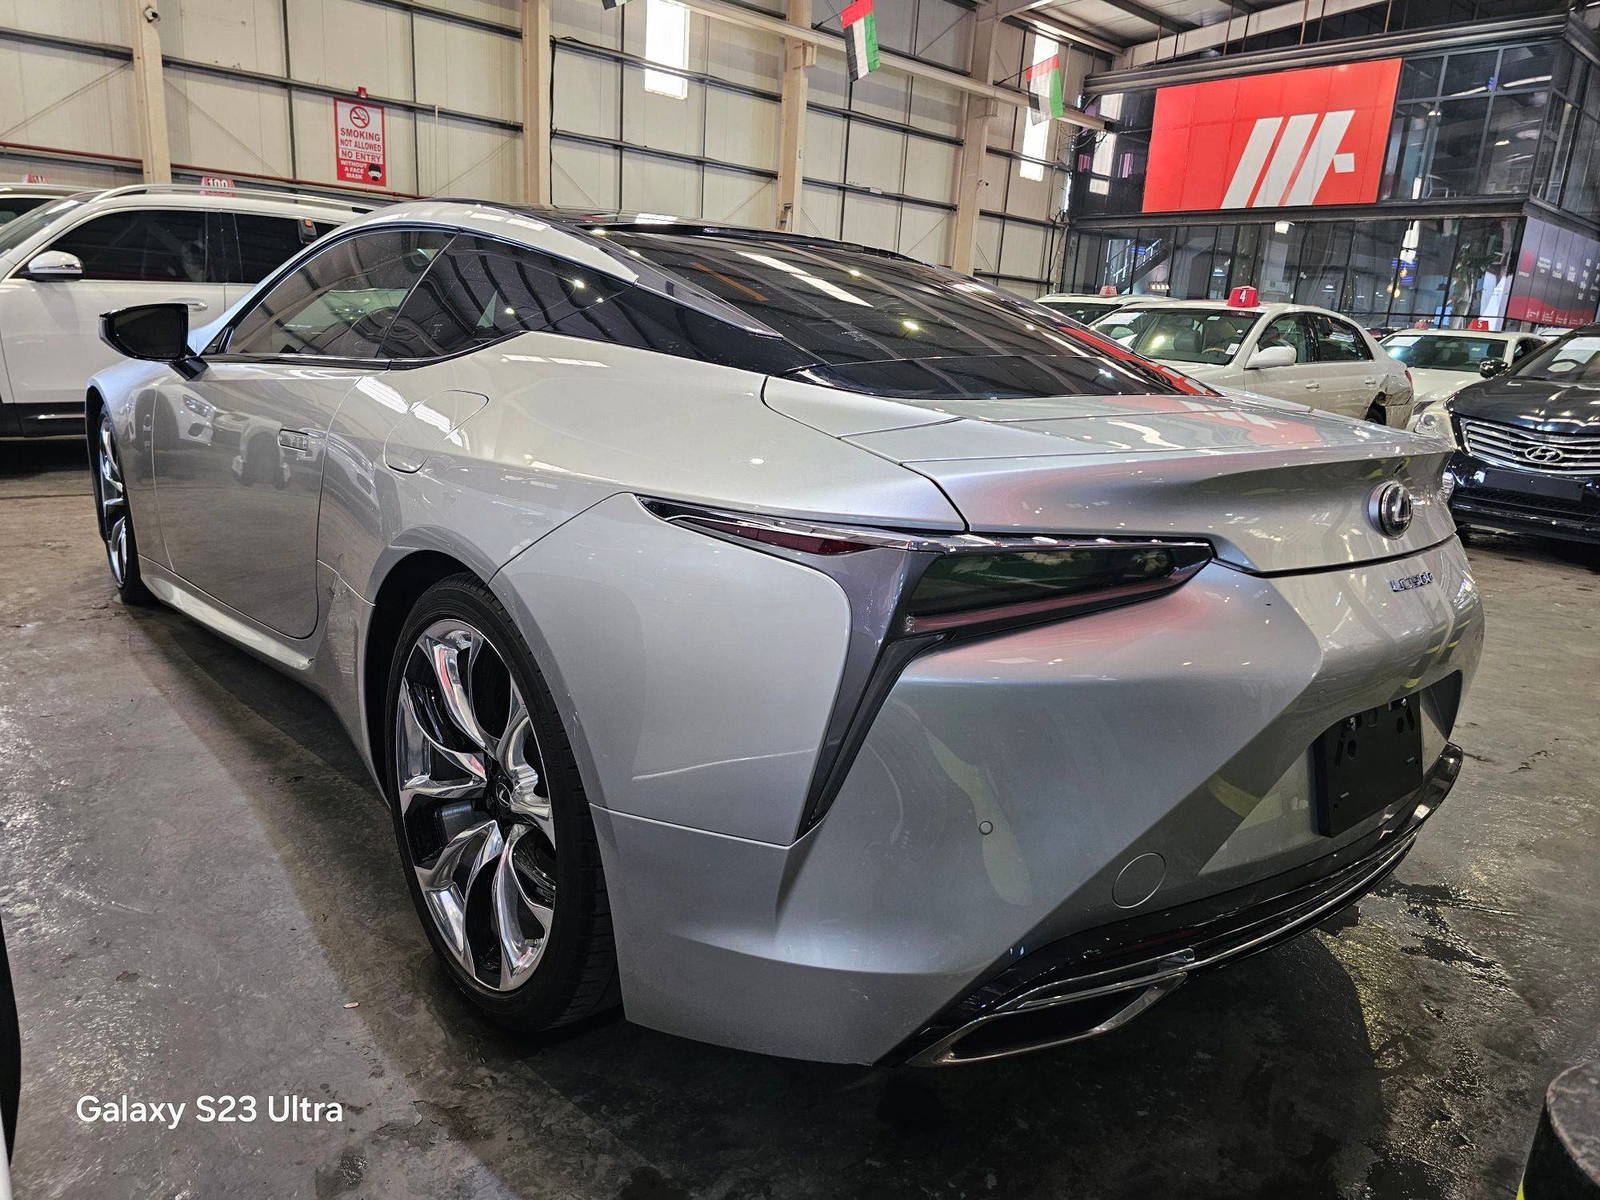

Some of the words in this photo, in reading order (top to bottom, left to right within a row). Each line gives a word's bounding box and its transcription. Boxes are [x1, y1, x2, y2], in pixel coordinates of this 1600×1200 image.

[340, 128, 380, 141] SMOKING
[340, 138, 352, 148] NOT
[354, 141, 382, 152] ALLOWED
[341, 150, 353, 159] NO
[355, 153, 381, 163] ENTRY
[340, 160, 367, 169] WITHOUT
[1239, 289, 1247, 303] 4
